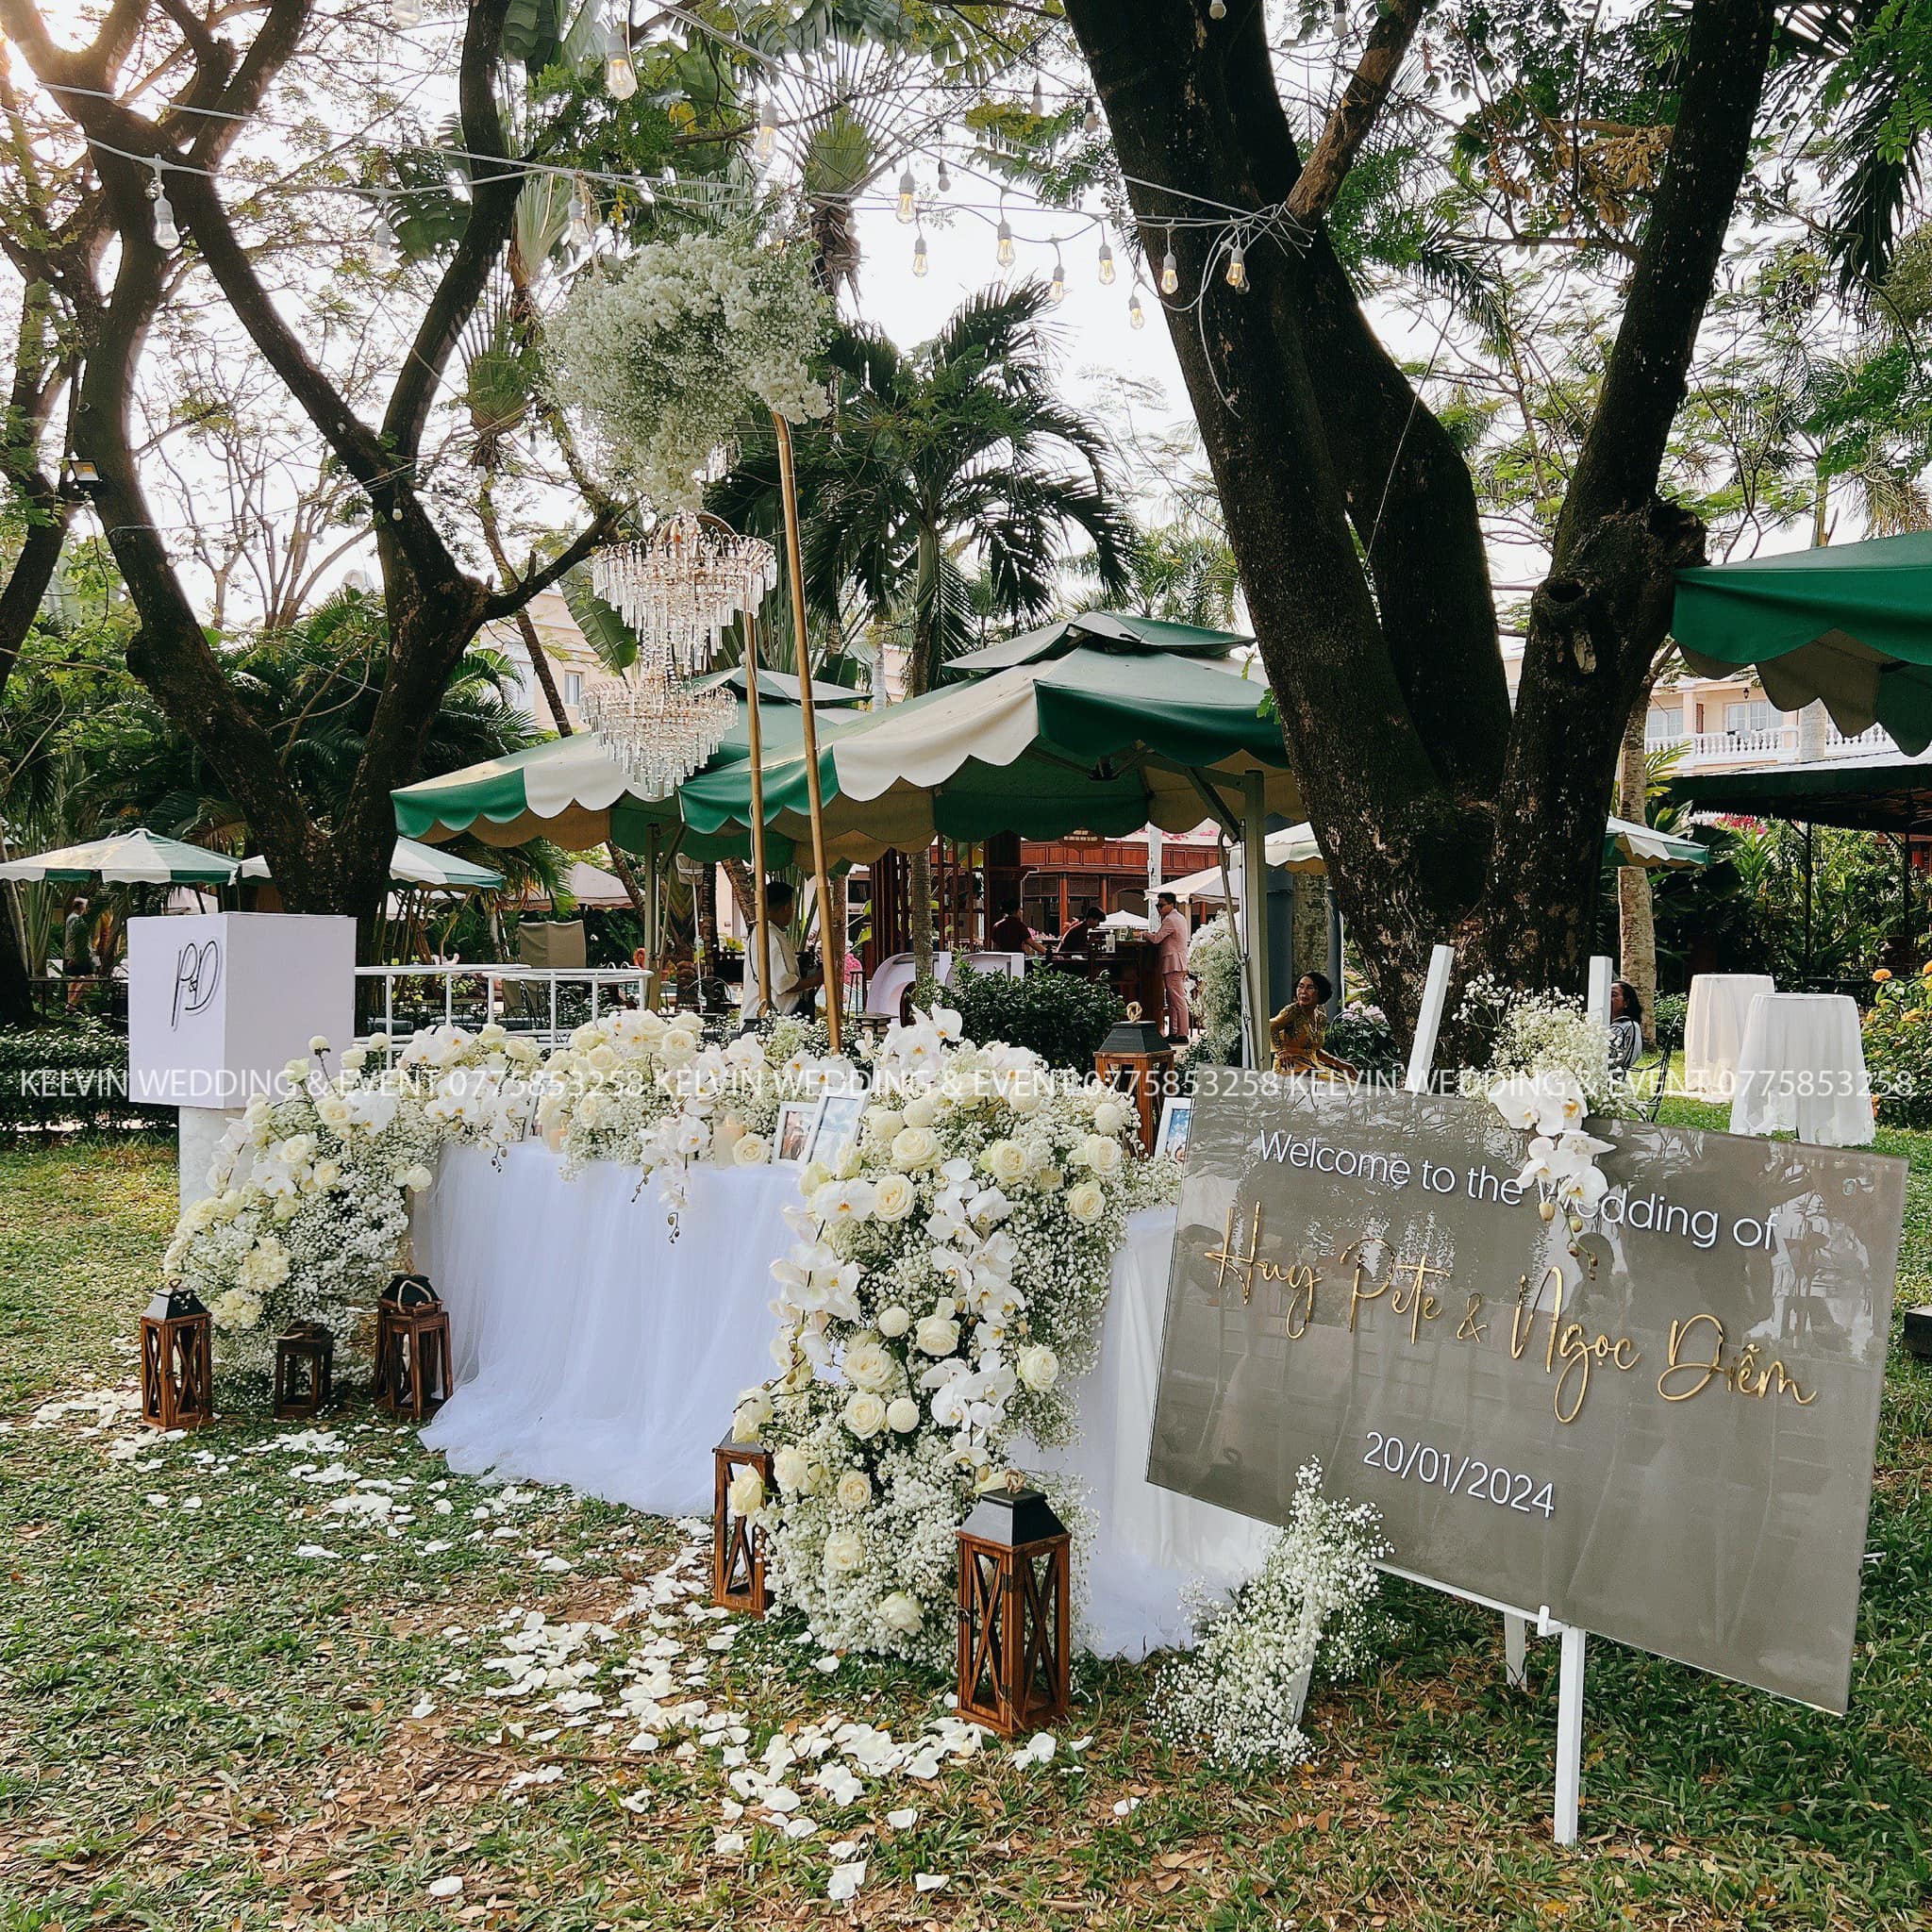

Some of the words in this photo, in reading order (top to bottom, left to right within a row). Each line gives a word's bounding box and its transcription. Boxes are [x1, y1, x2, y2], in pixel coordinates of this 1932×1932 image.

[1259, 1129, 1412, 1185] Welcome
[1421, 1159, 1457, 1193] to
[1467, 1165, 1524, 1206] the
[1732, 1212, 1780, 1250] of
[1204, 1200, 1323, 1340] Huy
[1339, 1237, 1451, 1345] Pete
[1456, 1292, 1489, 1344] &
[1510, 1266, 1641, 1424] Ngọc
[1363, 1431, 1555, 1518] 20/01/2024
